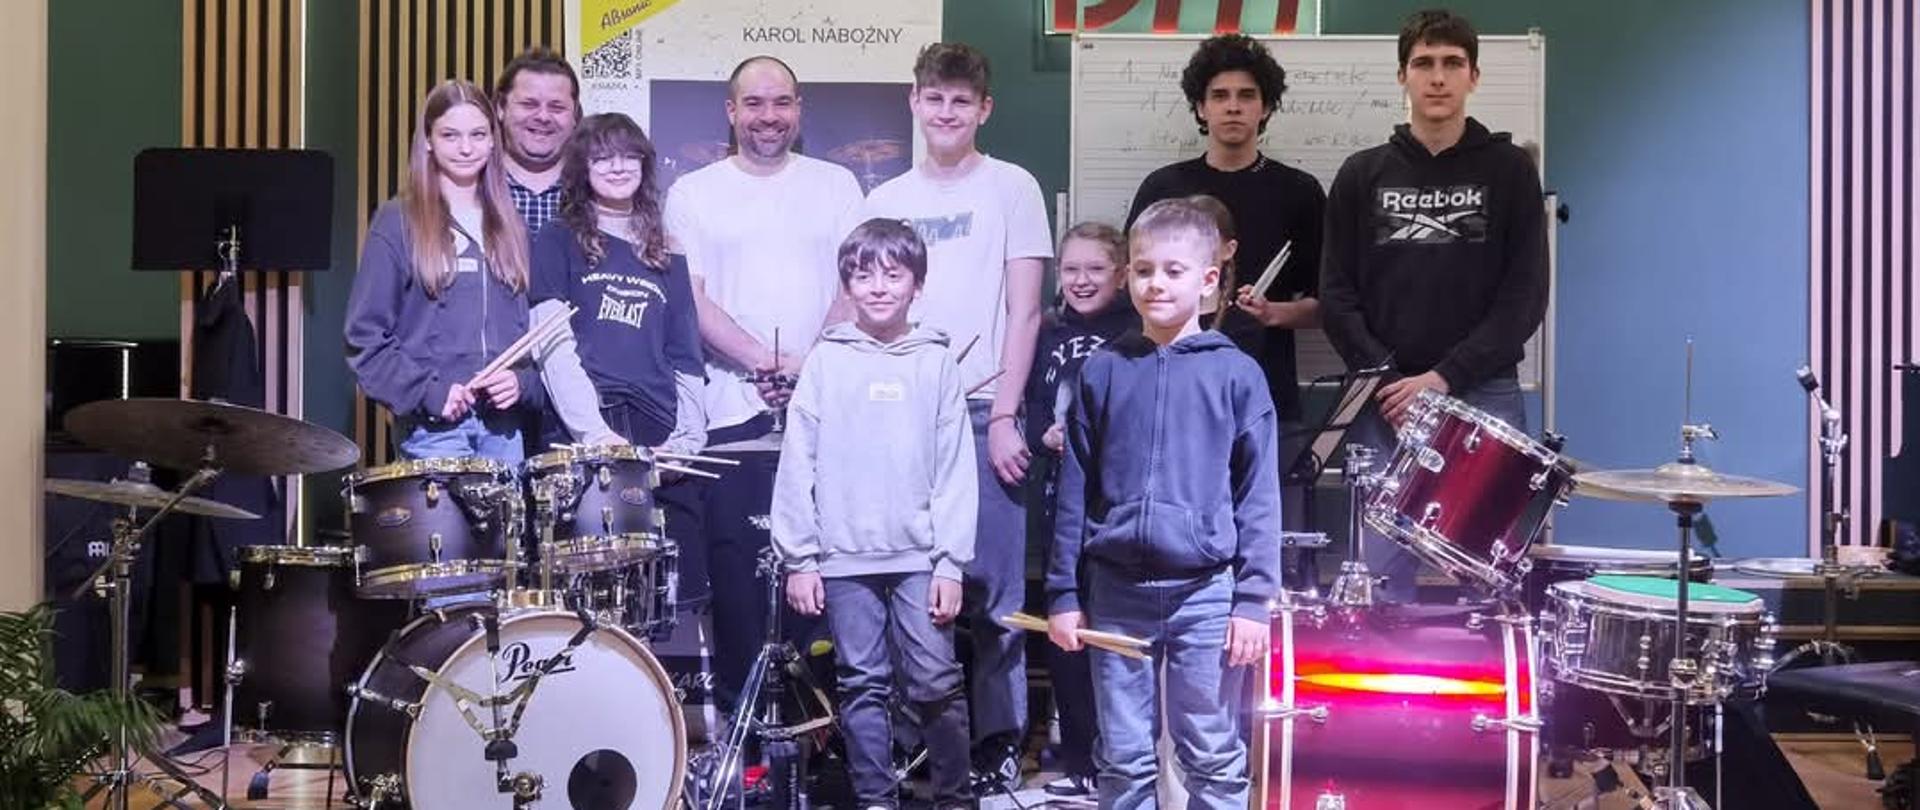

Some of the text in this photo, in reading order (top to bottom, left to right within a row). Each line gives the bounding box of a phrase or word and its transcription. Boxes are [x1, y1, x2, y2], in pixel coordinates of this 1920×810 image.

[742, 25, 903, 44] KAROL NABOŻNY
[1383, 188, 1482, 212] Reebok
[582, 272, 624, 285] HEAVY
[597, 293, 649, 329] EVERLAST
[501, 641, 576, 684] Pea
